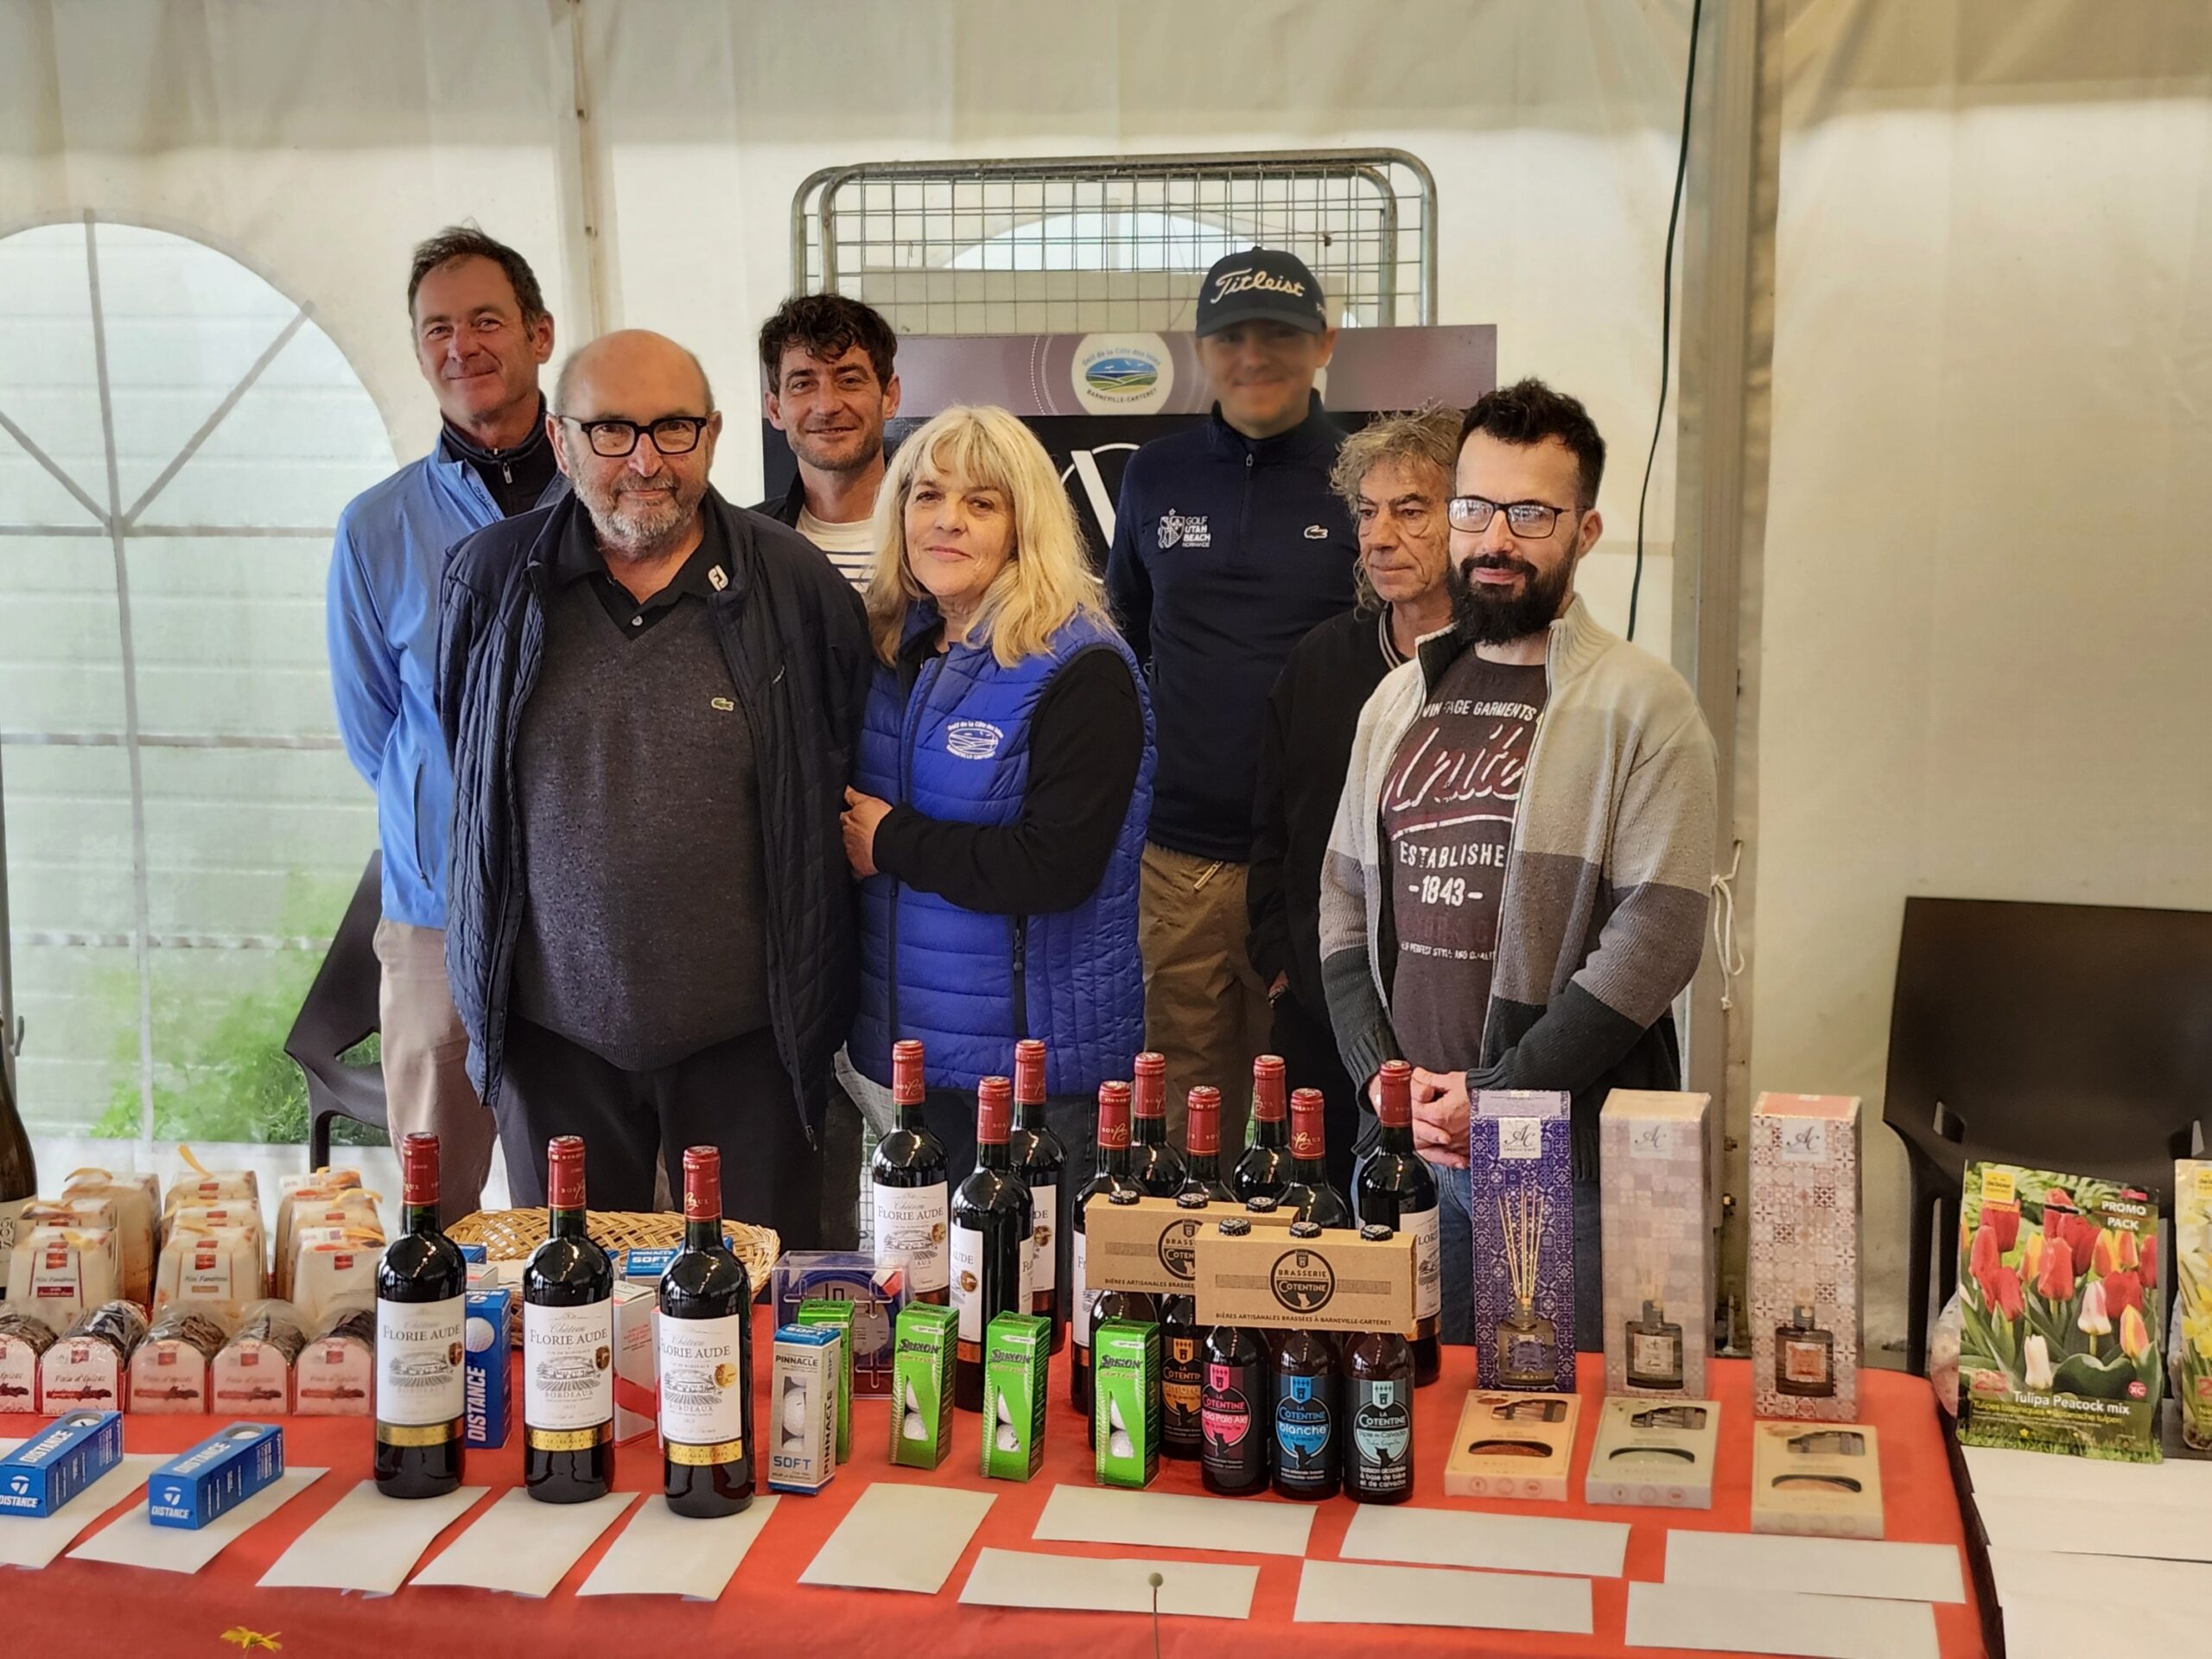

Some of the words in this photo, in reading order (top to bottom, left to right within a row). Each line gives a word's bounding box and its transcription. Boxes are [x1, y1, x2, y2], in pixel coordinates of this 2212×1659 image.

[1210, 268, 1306, 304] Titleist
[1185, 516, 1208, 525] GOLF
[1185, 524, 1208, 534] UTAH
[1184, 533, 1211, 543] BEACH
[1422, 699, 1473, 718] VINAGE
[1472, 701, 1538, 722] GARMENTS
[1399, 840, 1506, 869] ESTABLISHE
[877, 1205, 915, 1221] FLORIE
[917, 1206, 944, 1221] AUDE
[1033, 1210, 1049, 1219] DE
[2101, 1199, 2147, 1217] PROMO
[2107, 1217, 2139, 1230] PACK
[1165, 1237, 1195, 1246] BRASS
[1166, 1249, 1195, 1262] COTEN
[1278, 1268, 1327, 1278] BRASSERIE
[1126, 1279, 1167, 1287] ARTISANALES
[1278, 1281, 1327, 1294] COTENTINE
[1238, 1313, 1281, 1322] ARTISANALES
[1281, 1314, 1313, 1323] BRASSÉES
[1320, 1316, 1392, 1326] BARNEVILLE-CARTERET
[383, 1324, 428, 1342] FLORIE
[429, 1323, 461, 1341] AUDE
[530, 1328, 574, 1346] FLORIE
[575, 1327, 608, 1345] AUDE
[694, 1344, 732, 1360] AUDE
[896, 1338, 942, 1355] SRIXON
[775, 1354, 819, 1368] PINNACLE
[988, 1347, 1033, 1365] SRIXON
[1098, 1354, 1143, 1370] SRIXON
[1162, 1365, 1202, 1382] COTENTI
[544, 1389, 594, 1399] BORDEAUX
[1203, 1393, 1245, 1410] COTENTINE
[467, 1365, 486, 1442] DISTANCE
[669, 1403, 715, 1413] BORDEAUX
[2013, 1390, 2050, 1408] Tulipa
[2052, 1395, 2106, 1413] Peacock
[2107, 1402, 2132, 1416] mix
[1279, 1406, 1327, 1421] COTENTINE
[1358, 1414, 1407, 1428] COTENTINE
[823, 1389, 833, 1476] PINNACLE
[1279, 1421, 1327, 1436] blanche
[19, 1430, 74, 1464] DISTANCE
[173, 1441, 232, 1474] DISTANCE
[772, 1455, 812, 1470] SOFT
[0, 1495, 38, 1509] DISTANCE
[151, 1504, 190, 1520] DISTANCE
